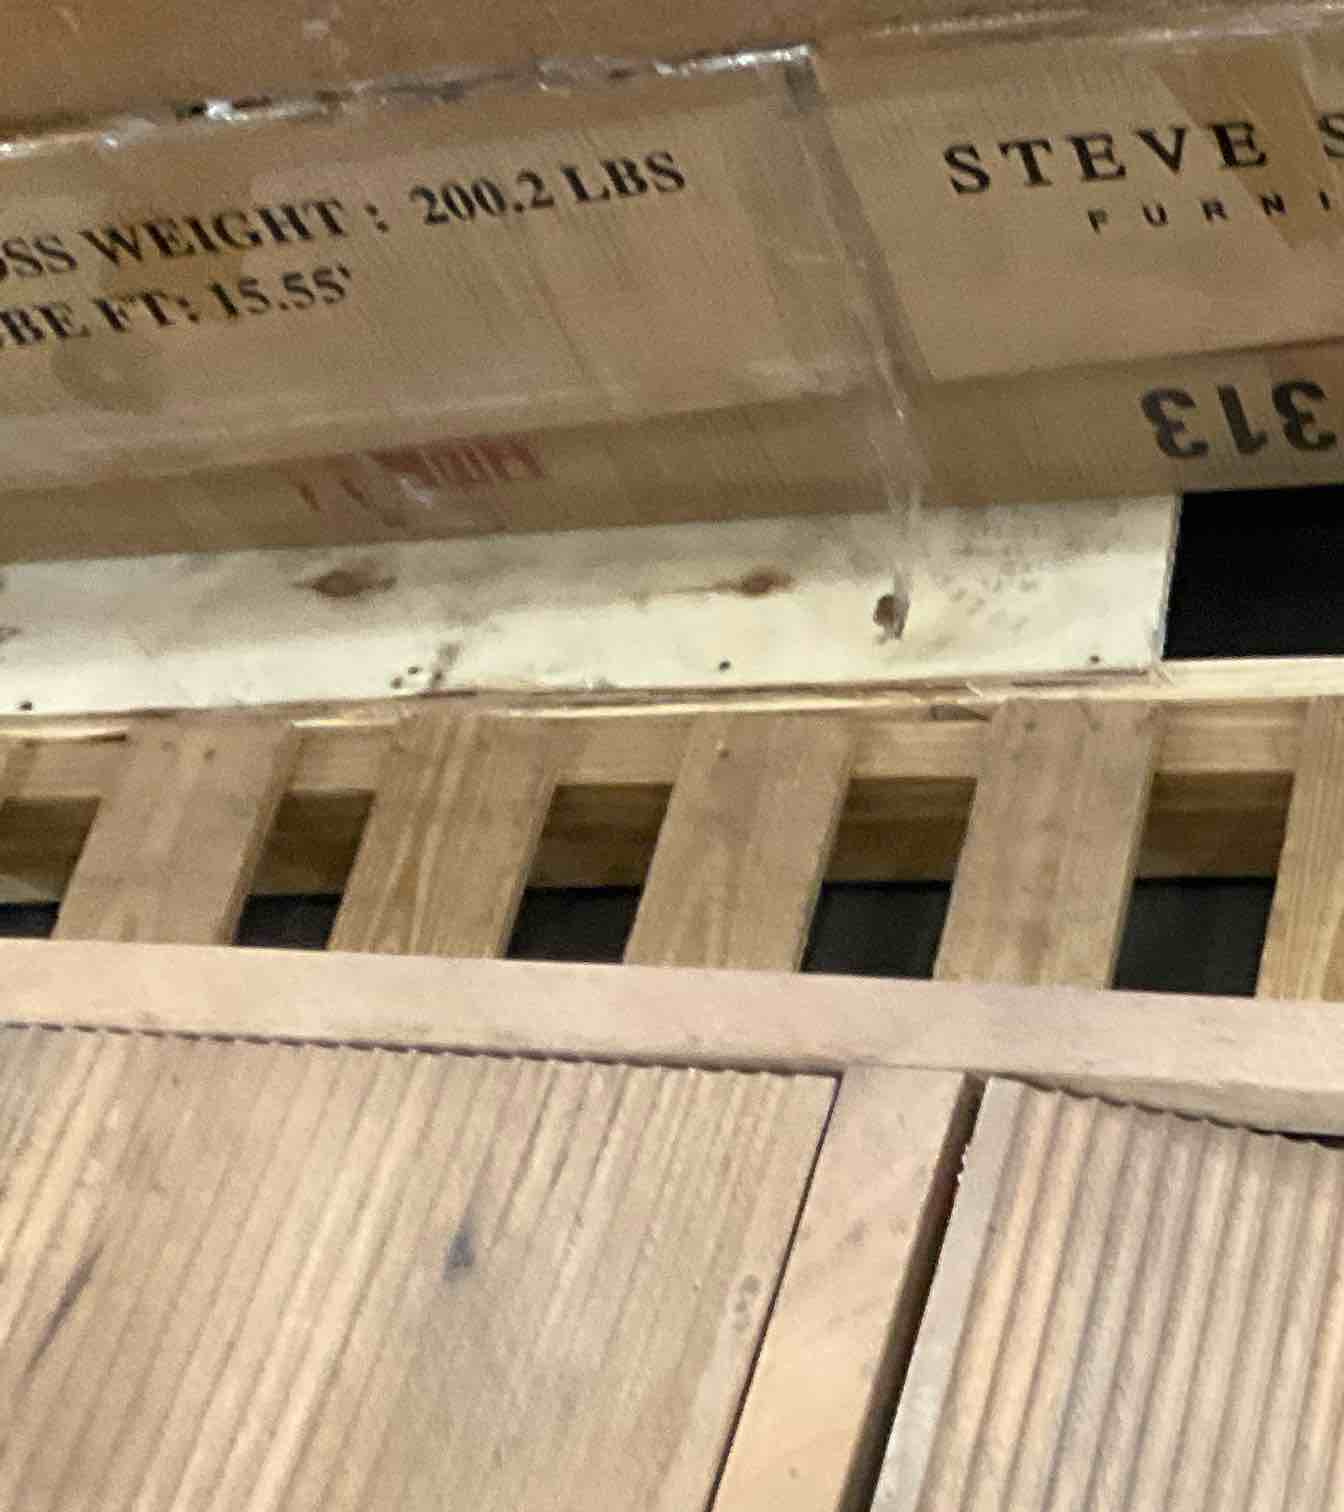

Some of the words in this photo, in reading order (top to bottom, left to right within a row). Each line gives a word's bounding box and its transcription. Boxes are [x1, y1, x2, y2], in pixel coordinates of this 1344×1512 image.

[942, 119, 1268, 195] STEVE
[0, 235, 78, 282] SS
[79, 197, 347, 266] WEIGHT
[409, 168, 555, 227] 200.2
[559, 151, 686, 204] LBS
[0, 302, 92, 347] BE
[92, 287, 200, 334] FT:
